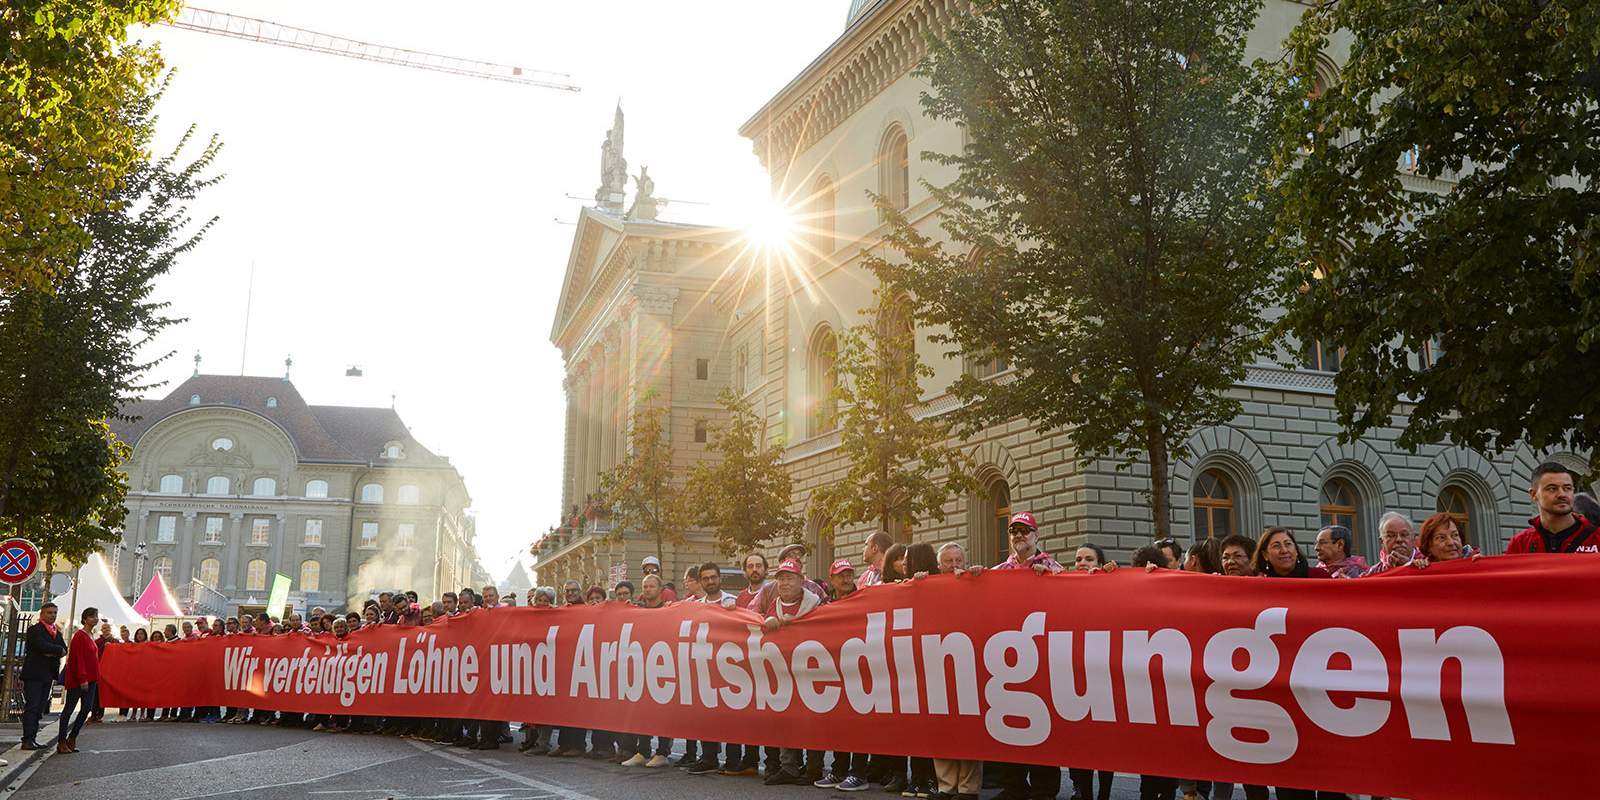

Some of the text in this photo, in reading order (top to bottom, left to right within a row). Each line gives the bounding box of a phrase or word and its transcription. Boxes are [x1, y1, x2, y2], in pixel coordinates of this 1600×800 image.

[224, 608, 1516, 764] Wir verteidigen Löhne und Arbeitsbedingungen
